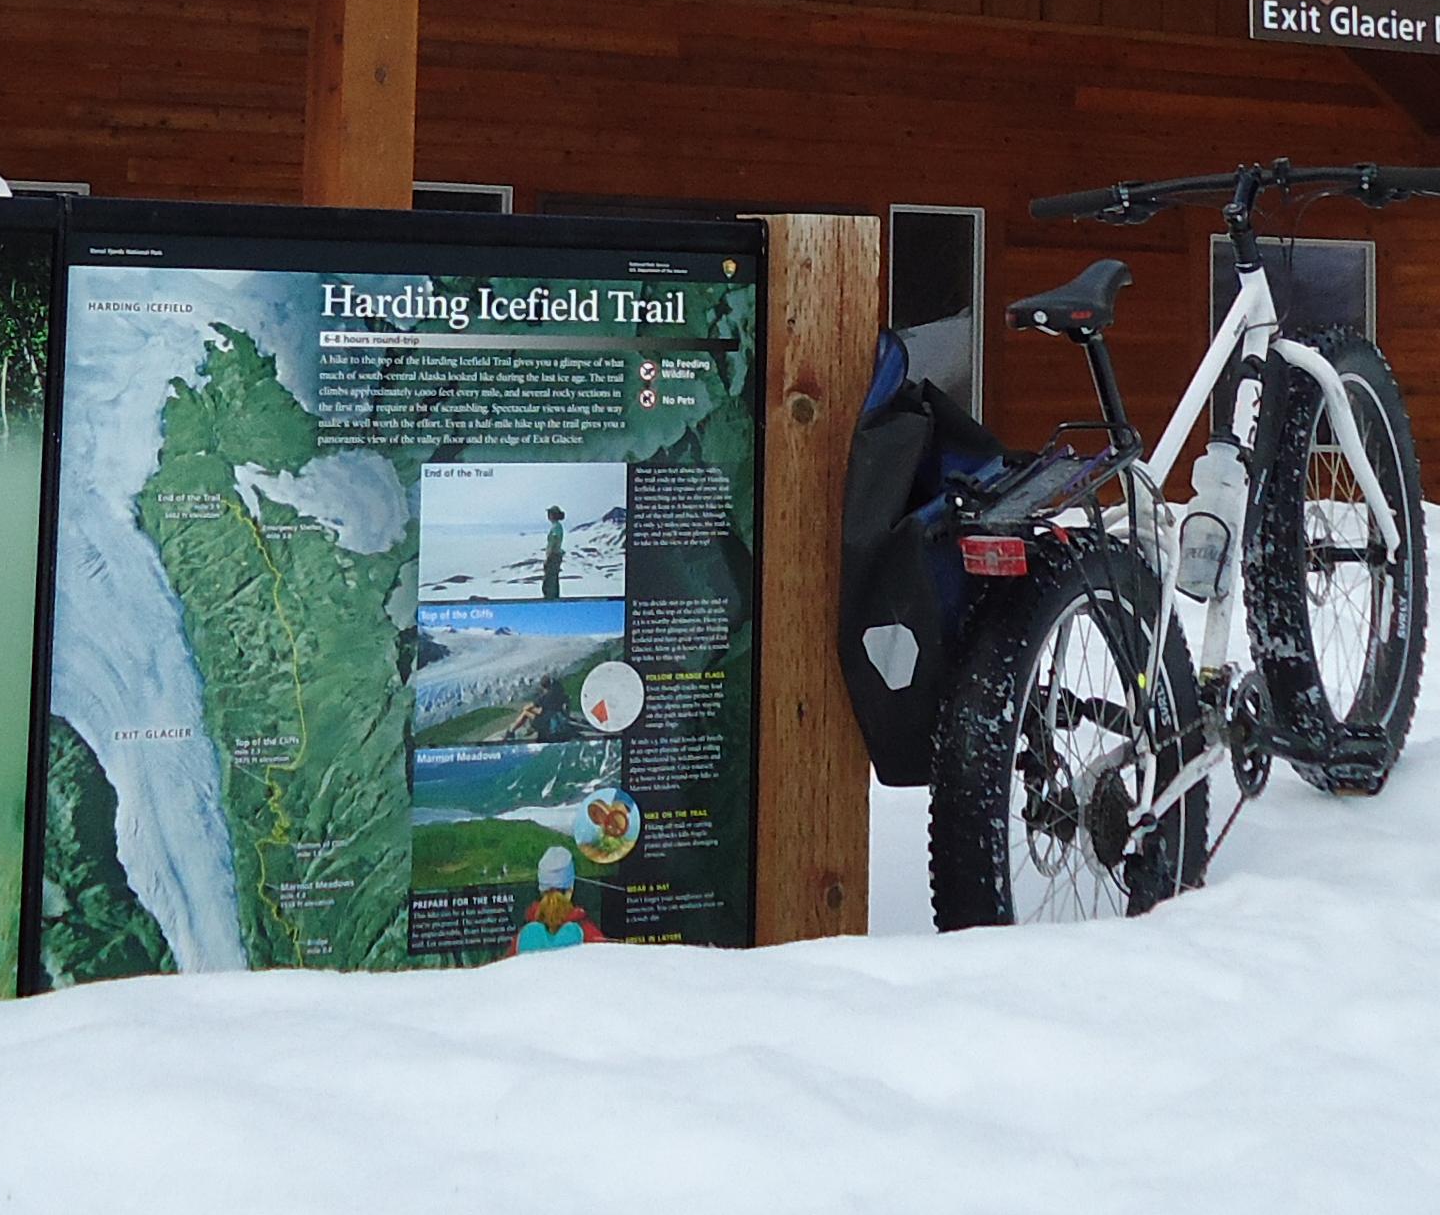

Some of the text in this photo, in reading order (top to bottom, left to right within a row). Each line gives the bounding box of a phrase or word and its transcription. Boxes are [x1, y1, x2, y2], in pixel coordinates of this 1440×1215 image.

[1262, 0, 1322, 32] Exit
[1329, 6, 1427, 40] Glacier
[88, 302, 193, 312] HARDING ICEFIELD
[321, 284, 686, 329] Harding Icefield Trail
[343, 336, 370, 344] hours
[372, 336, 420, 346] round-trip
[319, 354, 625, 369] A hike to the top of the Harding Icefield Trail gives you a glimpse of what
[661, 359, 711, 371] No Feeding
[661, 369, 695, 378] Wildlife
[662, 395, 696, 405] No Pets
[424, 468, 494, 477] End of the Trail
[158, 493, 175, 502] End
[188, 493, 202, 502] the
[203, 493, 221, 503] Trail
[420, 609, 494, 622] Top of the Cliffs
[114, 728, 192, 740] EXIT GLACIER
[235, 736, 299, 748] Top of the Cliffs
[417, 751, 502, 762] Marmot Meadows
[280, 880, 355, 890] Marmot Meadows
[412, 895, 515, 909] PREPARE FOR THE TRAIL
